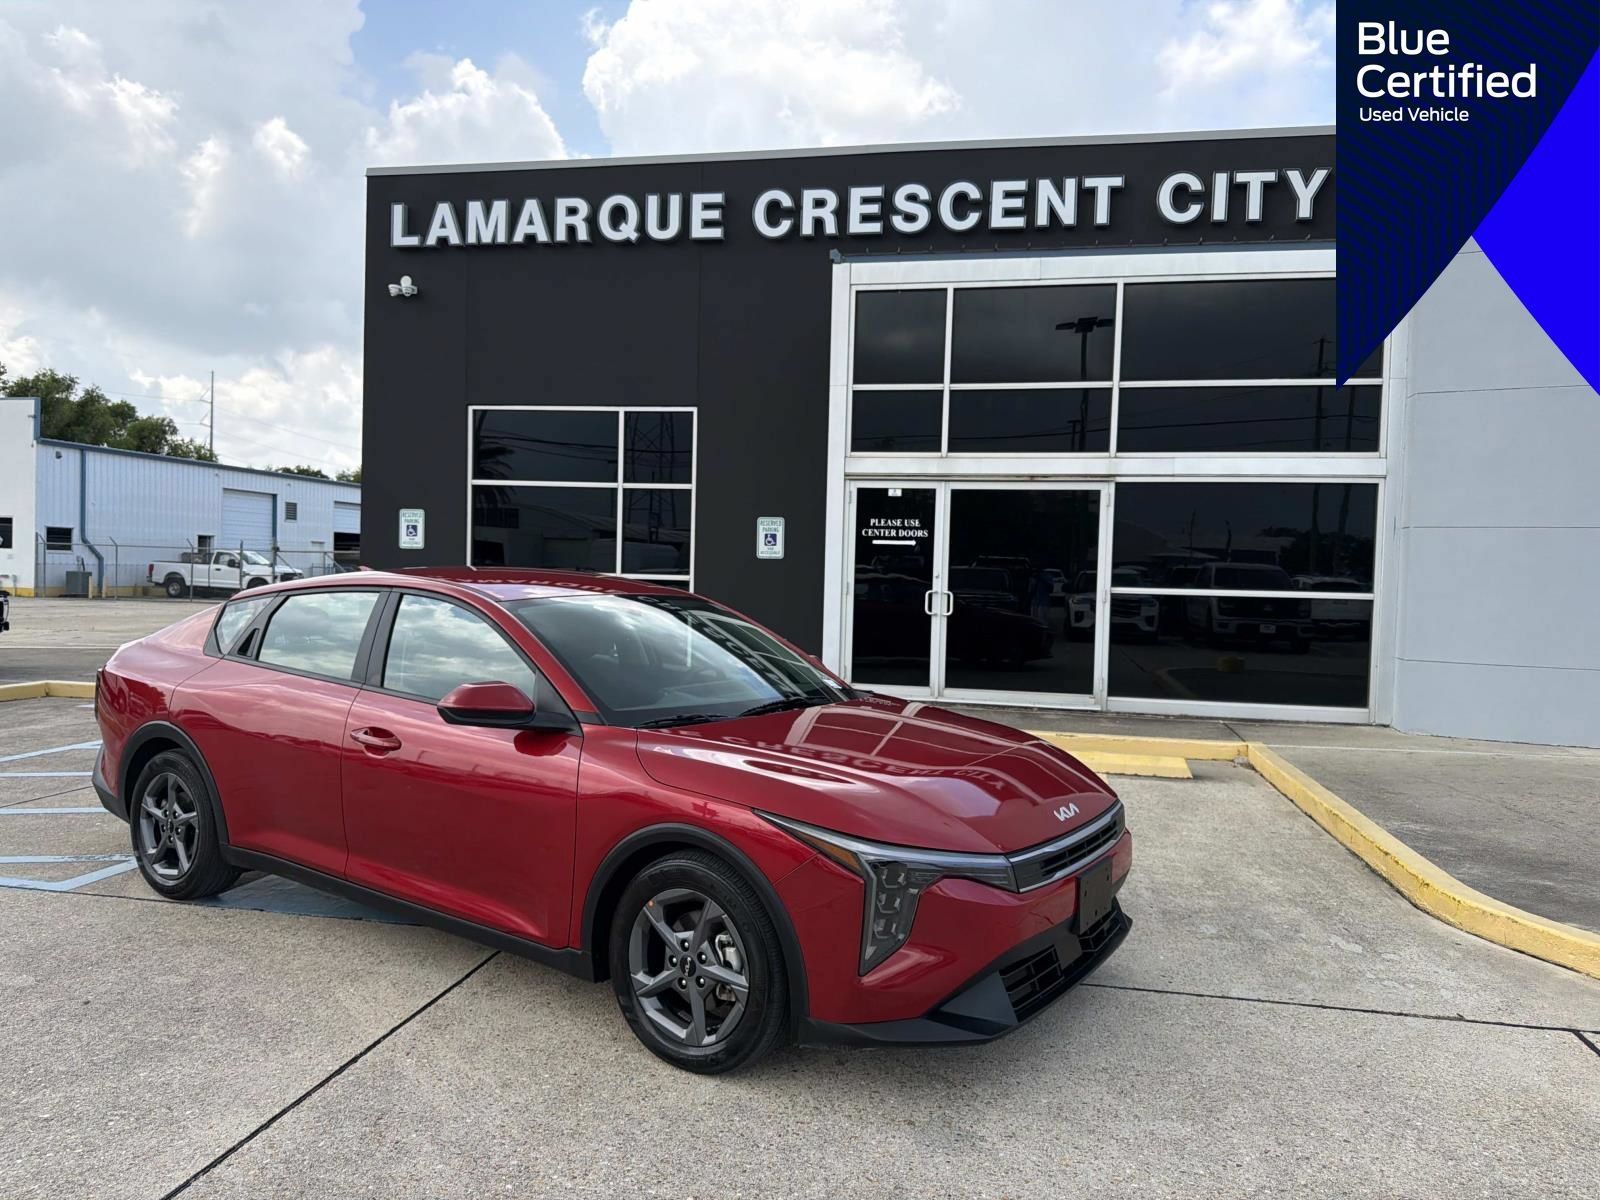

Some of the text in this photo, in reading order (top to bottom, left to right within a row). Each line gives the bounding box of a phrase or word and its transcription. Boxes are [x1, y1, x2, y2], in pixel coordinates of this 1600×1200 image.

[390, 167, 1333, 247] LAMARQUE CRESCENT CITY
[870, 518, 921, 527] PLEASE USE
[861, 528, 929, 538] CENTER DOORS
